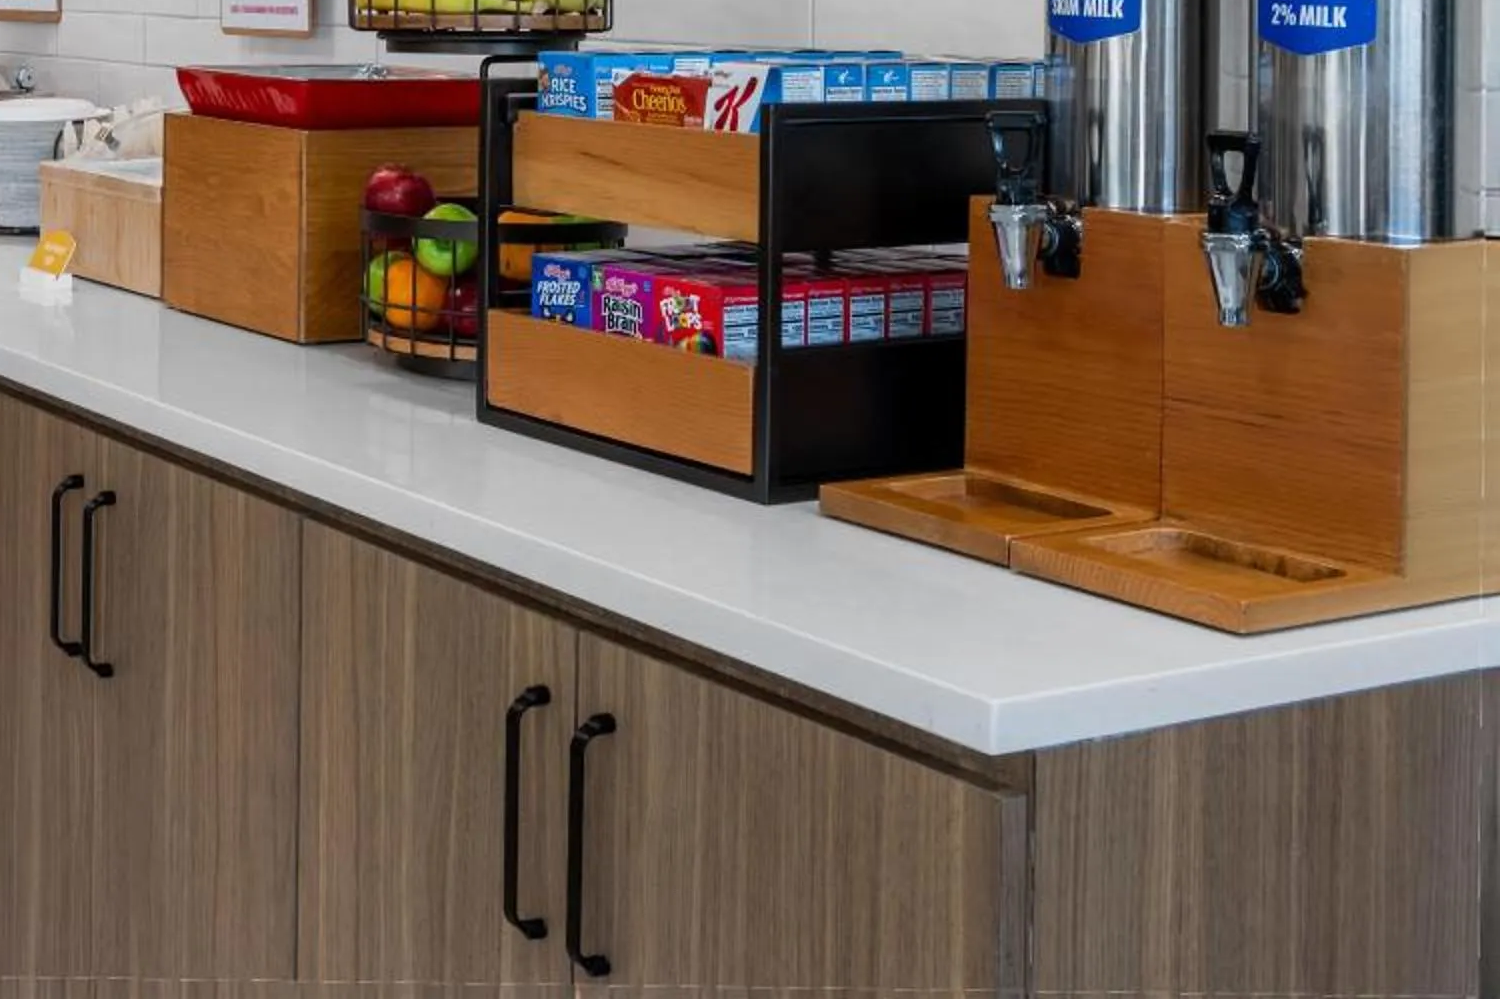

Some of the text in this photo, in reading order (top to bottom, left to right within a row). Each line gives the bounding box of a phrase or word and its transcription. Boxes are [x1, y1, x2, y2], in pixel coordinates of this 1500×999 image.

[1271, 2, 1348, 28] 2% MILK
[551, 78, 577, 94] RICE
[541, 92, 587, 112] KRISPIES
[632, 88, 688, 114] Cheerios
[537, 280, 581, 294] FROSTED
[539, 293, 576, 306] FLAKES
[603, 295, 641, 319] Raisin
[607, 312, 637, 334] Bran
